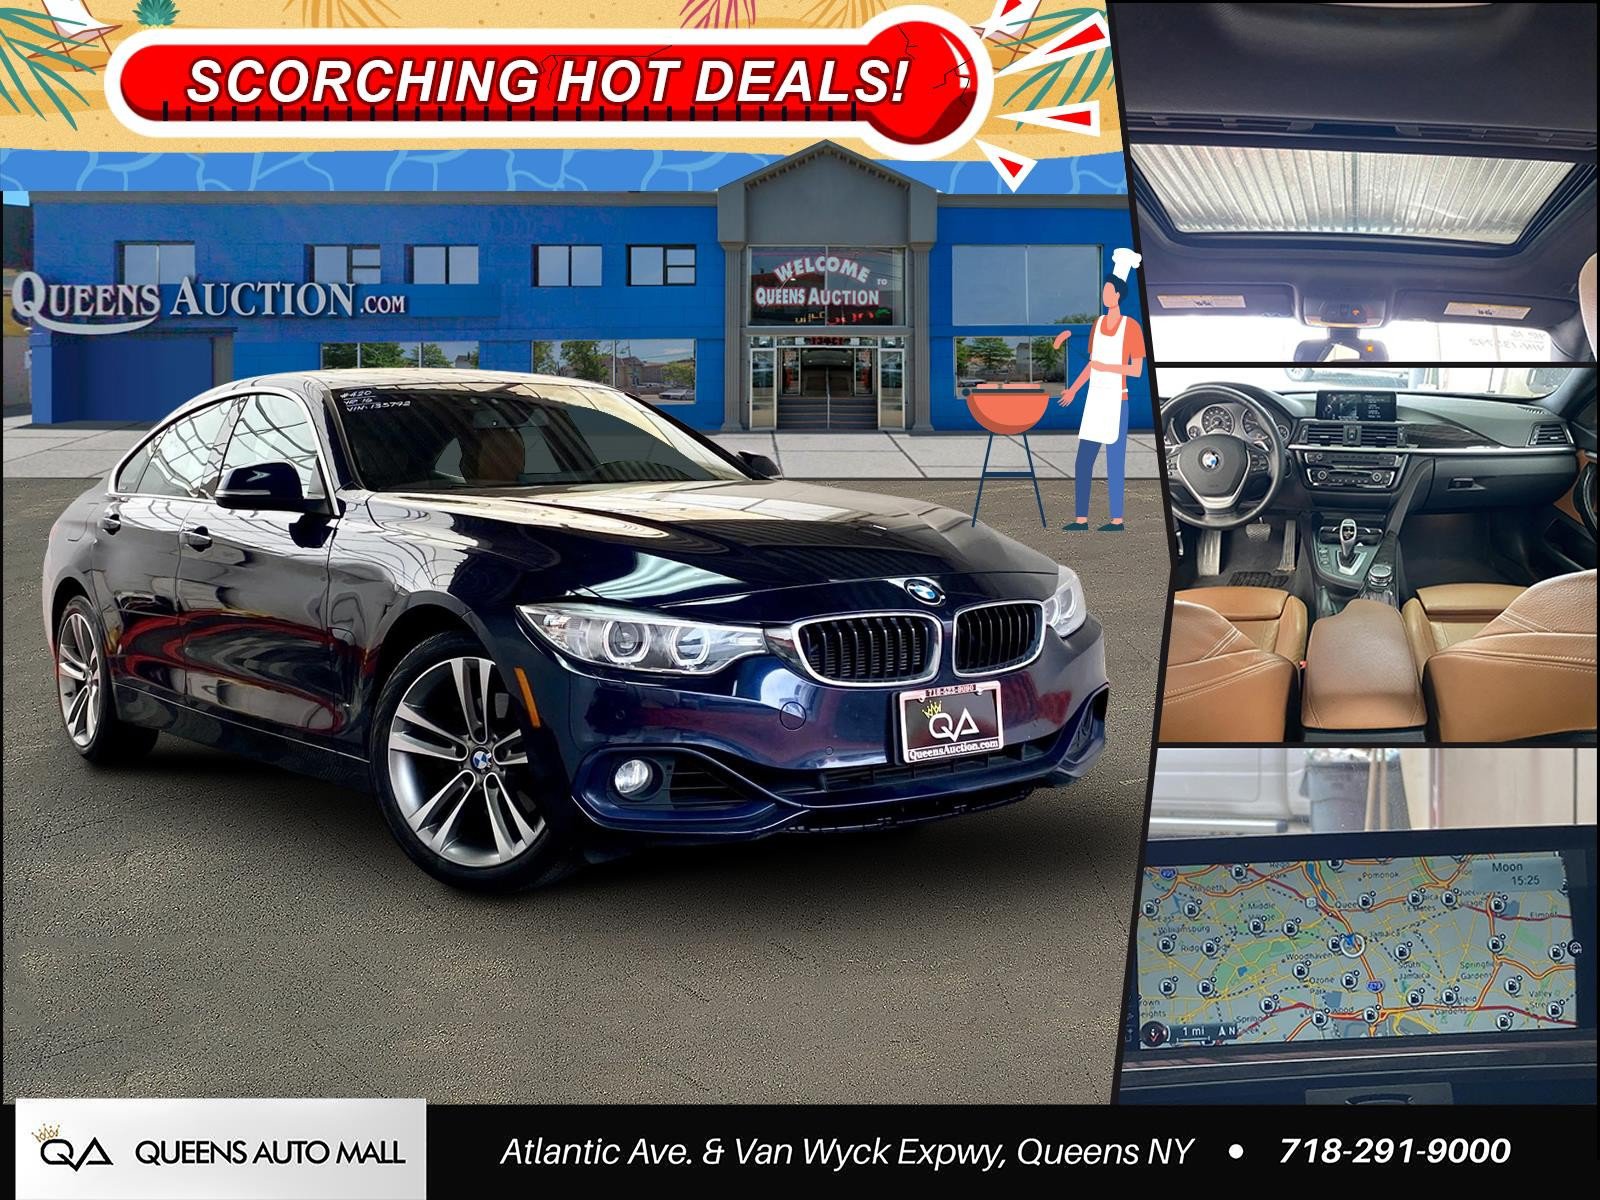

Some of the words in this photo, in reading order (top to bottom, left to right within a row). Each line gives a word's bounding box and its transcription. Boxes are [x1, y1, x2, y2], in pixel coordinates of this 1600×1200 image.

[774, 255, 871, 283] WELCOME
[807, 287, 880, 305] AUCTION
[909, 739, 999, 760] QueensAuction.com
[1511, 874, 1540, 885] 15:25
